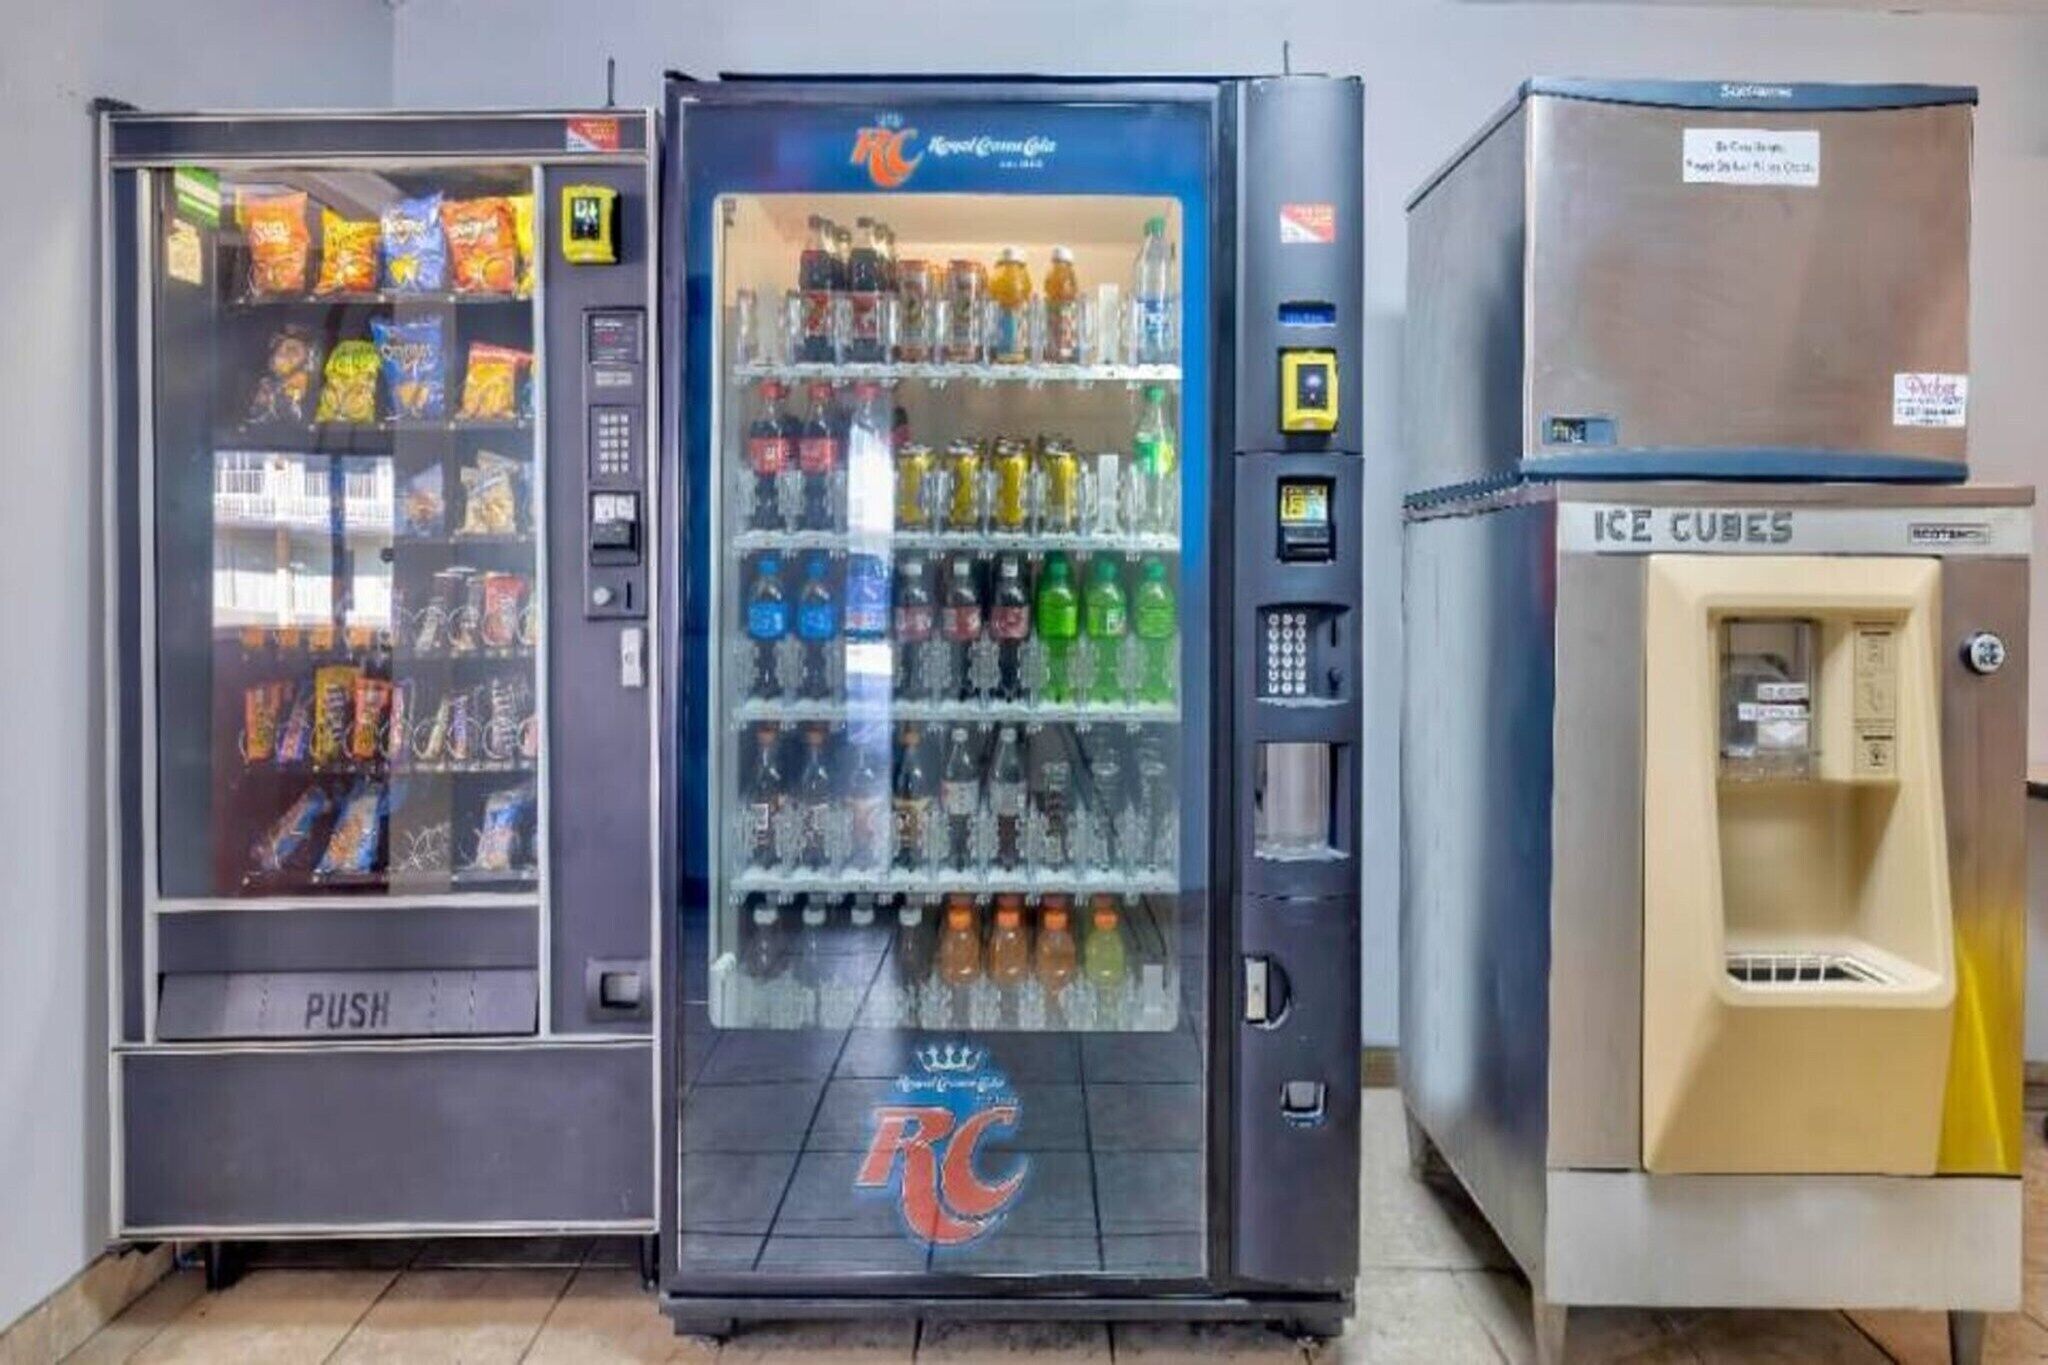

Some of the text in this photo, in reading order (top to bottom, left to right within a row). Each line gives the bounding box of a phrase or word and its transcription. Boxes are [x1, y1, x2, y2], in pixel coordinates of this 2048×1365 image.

[851, 127, 925, 187] RC
[1595, 509, 1794, 543] ICE CUBES
[304, 990, 390, 1029] PUSH
[854, 1106, 1029, 1245] RC
